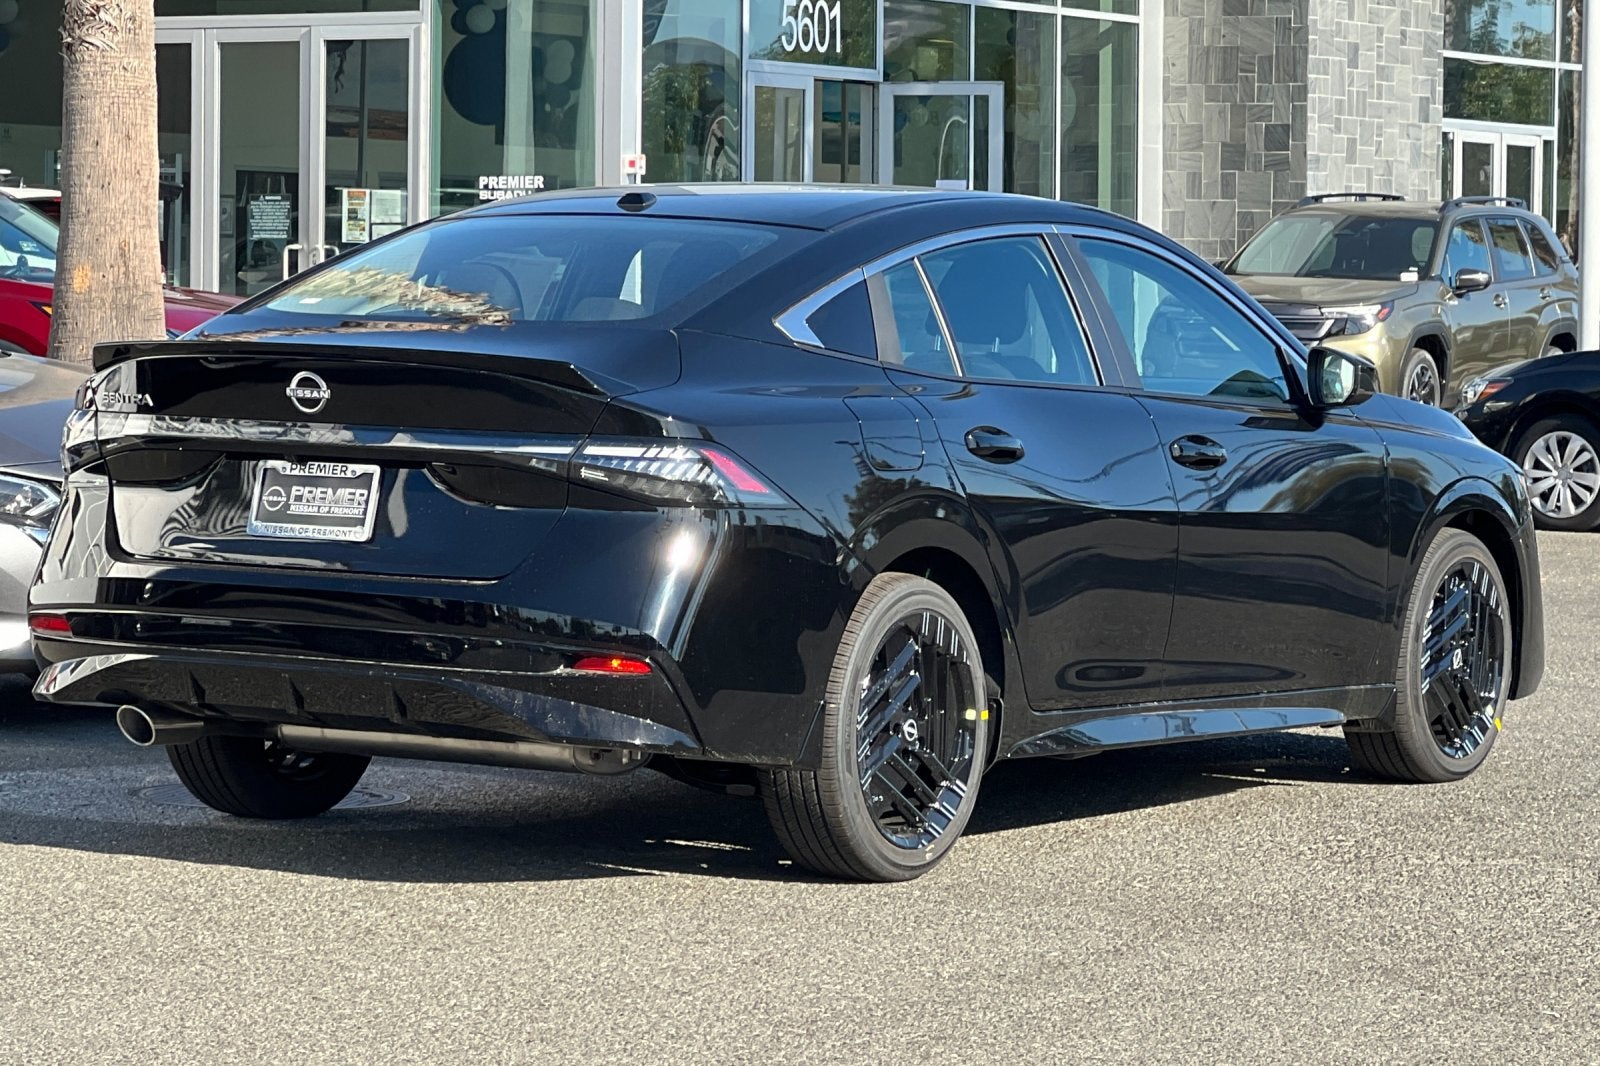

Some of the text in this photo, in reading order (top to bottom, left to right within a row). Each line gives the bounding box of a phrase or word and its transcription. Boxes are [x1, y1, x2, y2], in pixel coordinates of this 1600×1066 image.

[782, 0, 841, 53] 5601
[478, 175, 545, 189] PREMIER
[102, 391, 154, 407] SENTRA
[286, 387, 330, 399] NISSAN
[290, 462, 349, 476] PREMIER
[289, 485, 369, 507] PREMIER
[289, 504, 318, 513] NISSAN
[330, 507, 365, 515] FREMONT
[264, 525, 353, 537] NISSAN OF FREMONT
